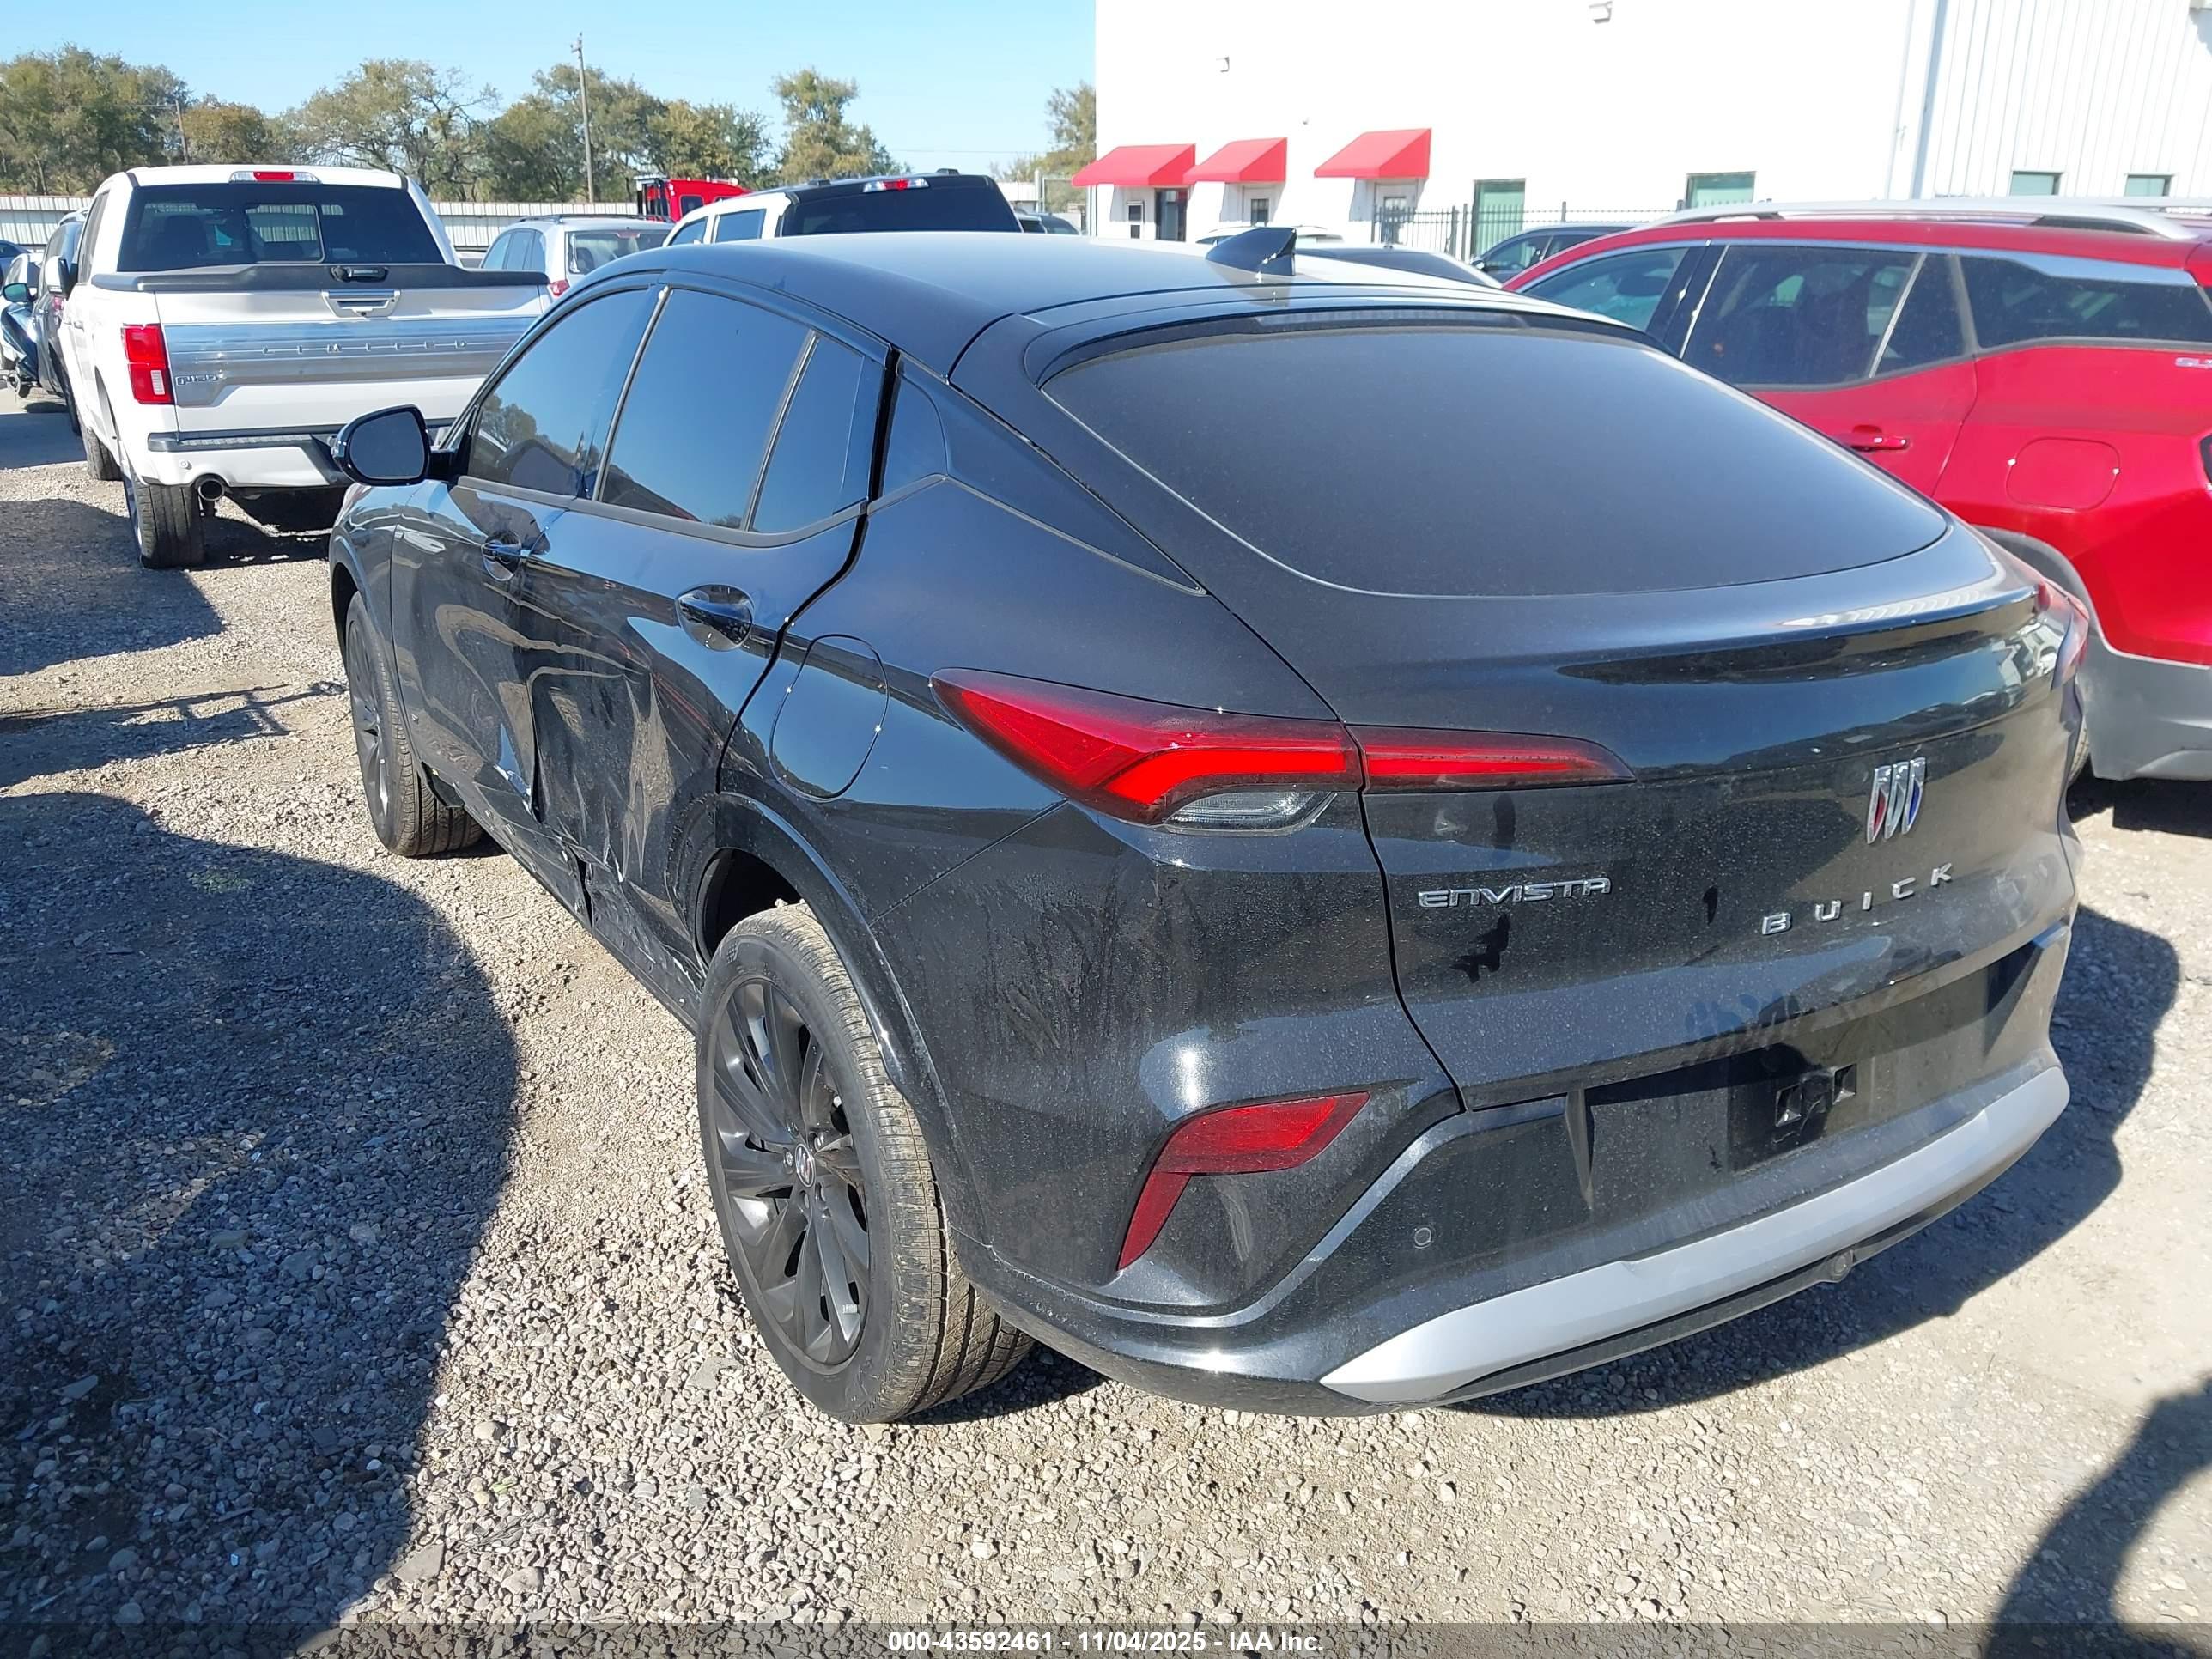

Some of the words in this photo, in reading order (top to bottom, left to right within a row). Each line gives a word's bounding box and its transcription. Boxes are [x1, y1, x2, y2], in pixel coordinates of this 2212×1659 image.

[263, 340, 467, 356] LIMITED
[1418, 877, 1612, 908] ENVISTA
[1761, 862, 1953, 936] BUICK
